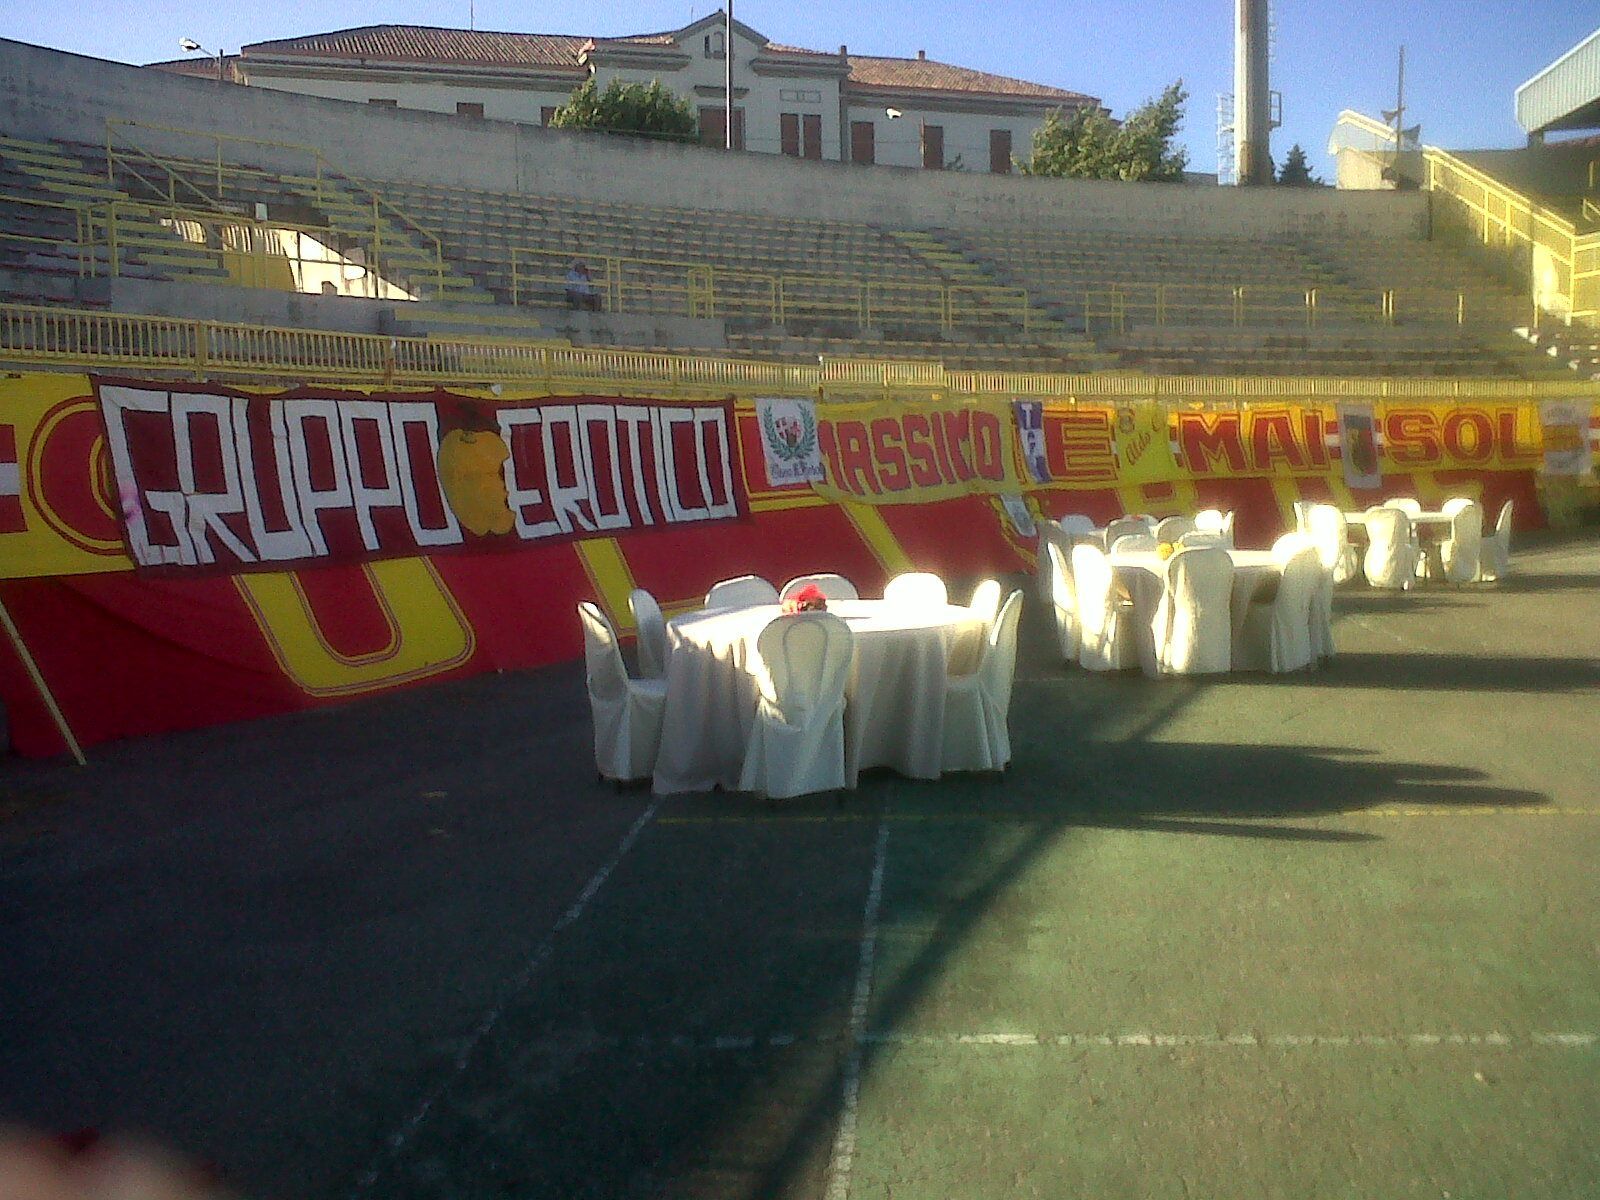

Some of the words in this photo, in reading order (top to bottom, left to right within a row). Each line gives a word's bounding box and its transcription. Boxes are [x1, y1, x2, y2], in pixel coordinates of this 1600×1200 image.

[99, 384, 464, 567] GRUPPO
[496, 404, 738, 539] EROTICO
[1179, 410, 1331, 474] MAI
[1384, 407, 1543, 464] SOL
